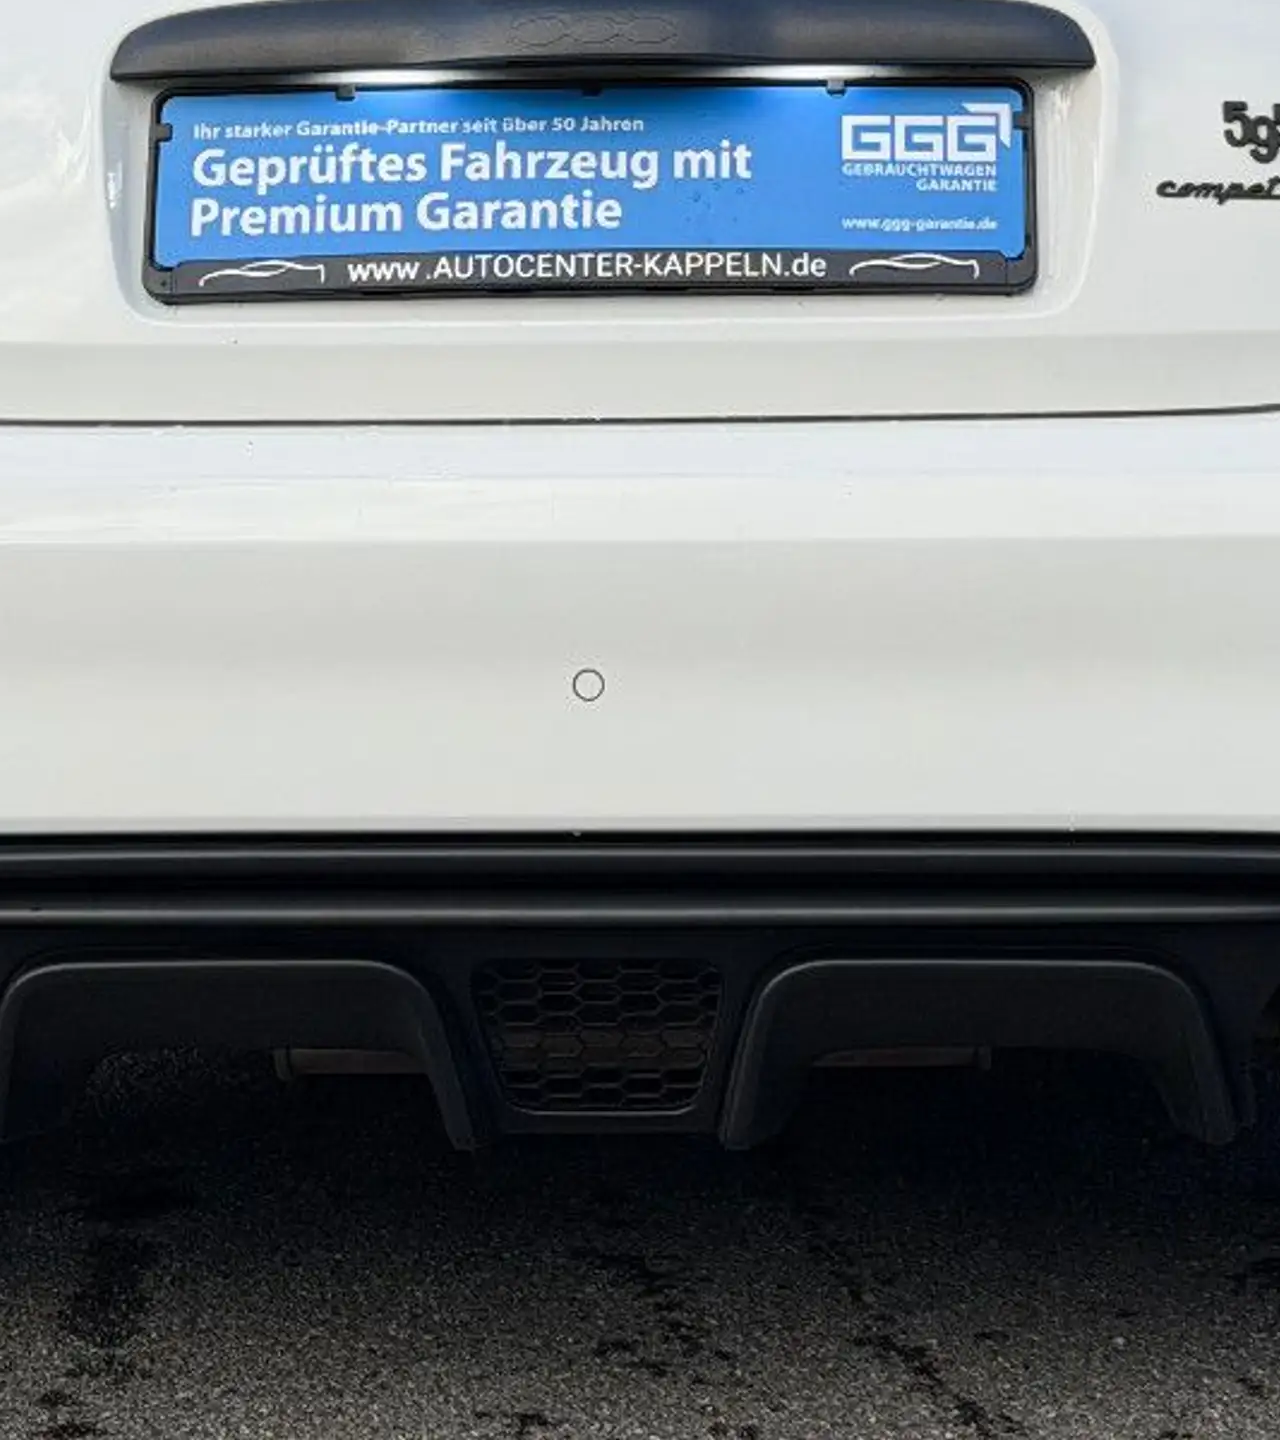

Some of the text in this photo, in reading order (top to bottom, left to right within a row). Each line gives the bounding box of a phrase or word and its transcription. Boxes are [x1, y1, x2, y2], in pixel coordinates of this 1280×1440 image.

[193, 115, 645, 141] Ihr starker Garantie-Partner seit über 50 Jahren
[841, 115, 997, 161] GGG
[192, 139, 752, 195] Geprüftes Fahrzeug mit
[841, 162, 997, 177] GEBRAUCHTWAGEN
[916, 178, 998, 191] GARANTIE
[190, 189, 623, 237] Premium Garantie
[841, 215, 998, 233] www.ggg-garantie.de
